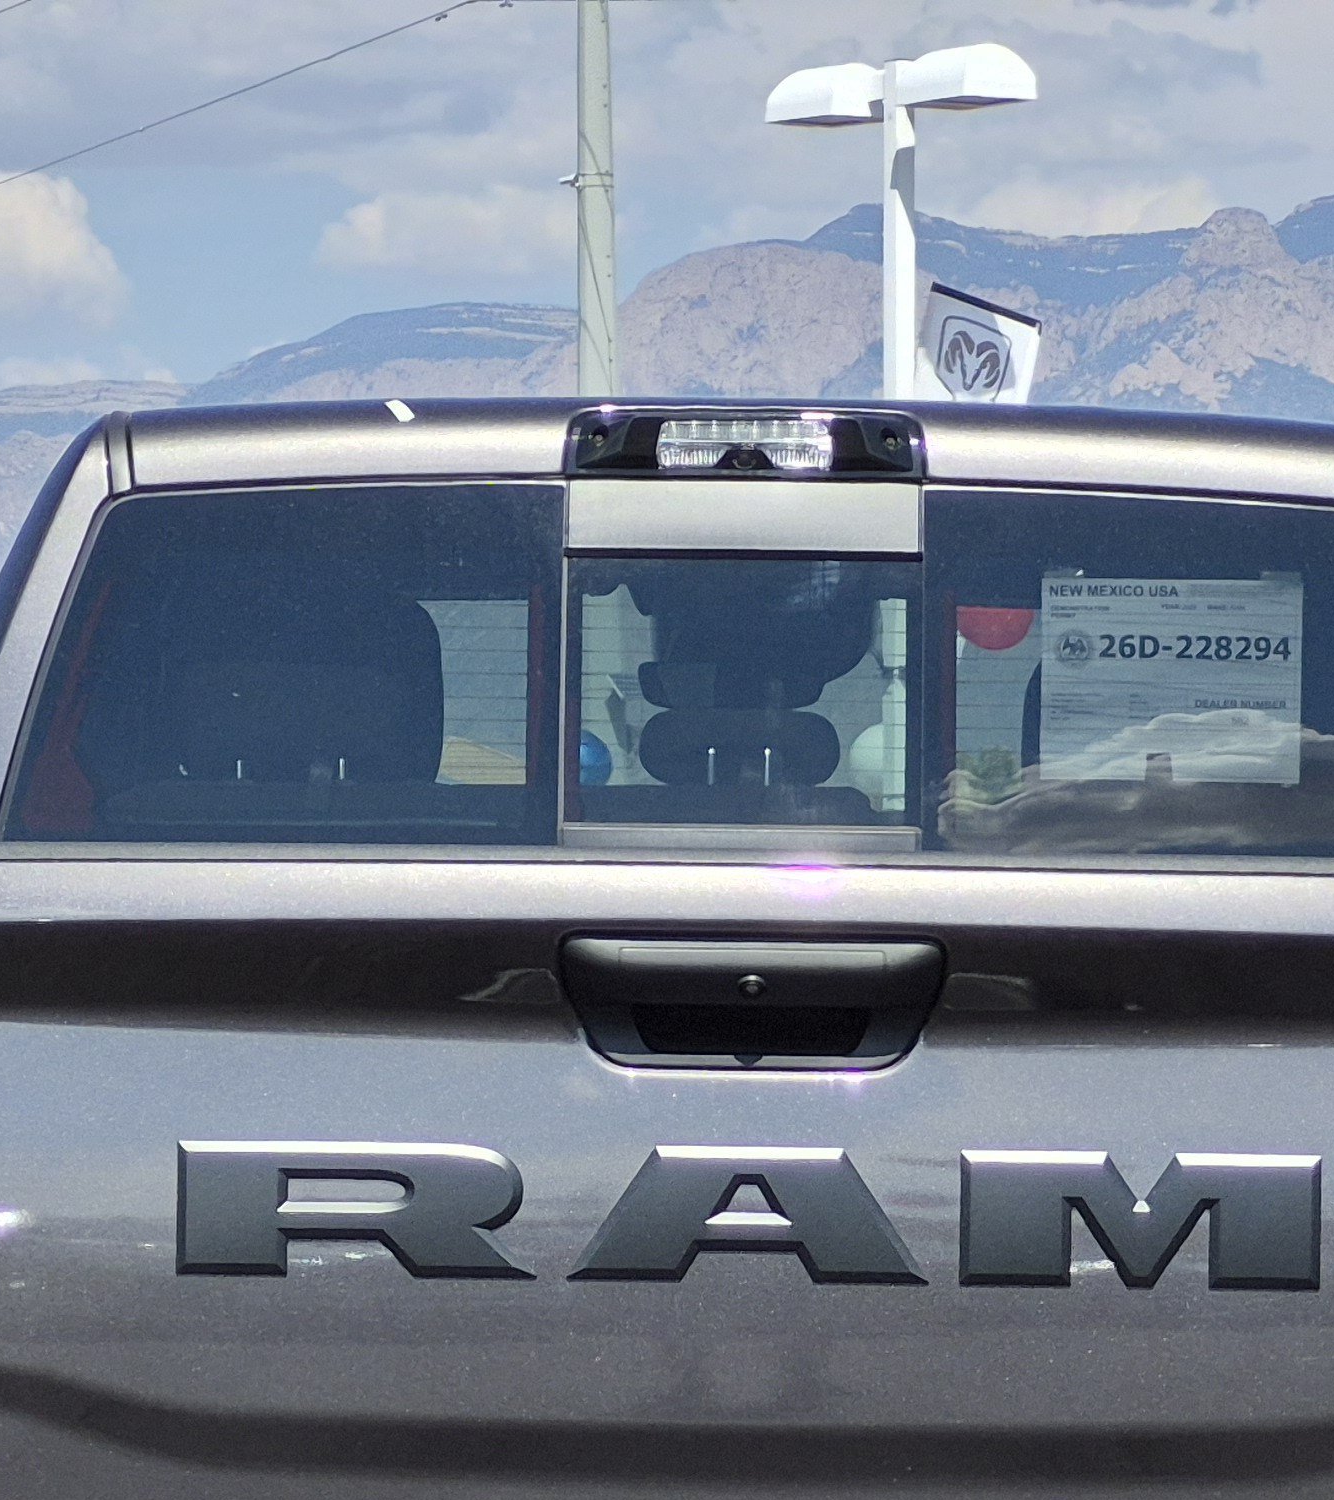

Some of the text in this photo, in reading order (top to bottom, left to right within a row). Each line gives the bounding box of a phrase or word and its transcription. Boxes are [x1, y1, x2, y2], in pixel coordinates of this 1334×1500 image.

[1049, 584, 1179, 598] NEW MEXICO USA
[1098, 633, 1292, 662] 26D-228294
[1194, 699, 1238, 709] DEALER
[175, 1138, 1324, 1292] RAM
